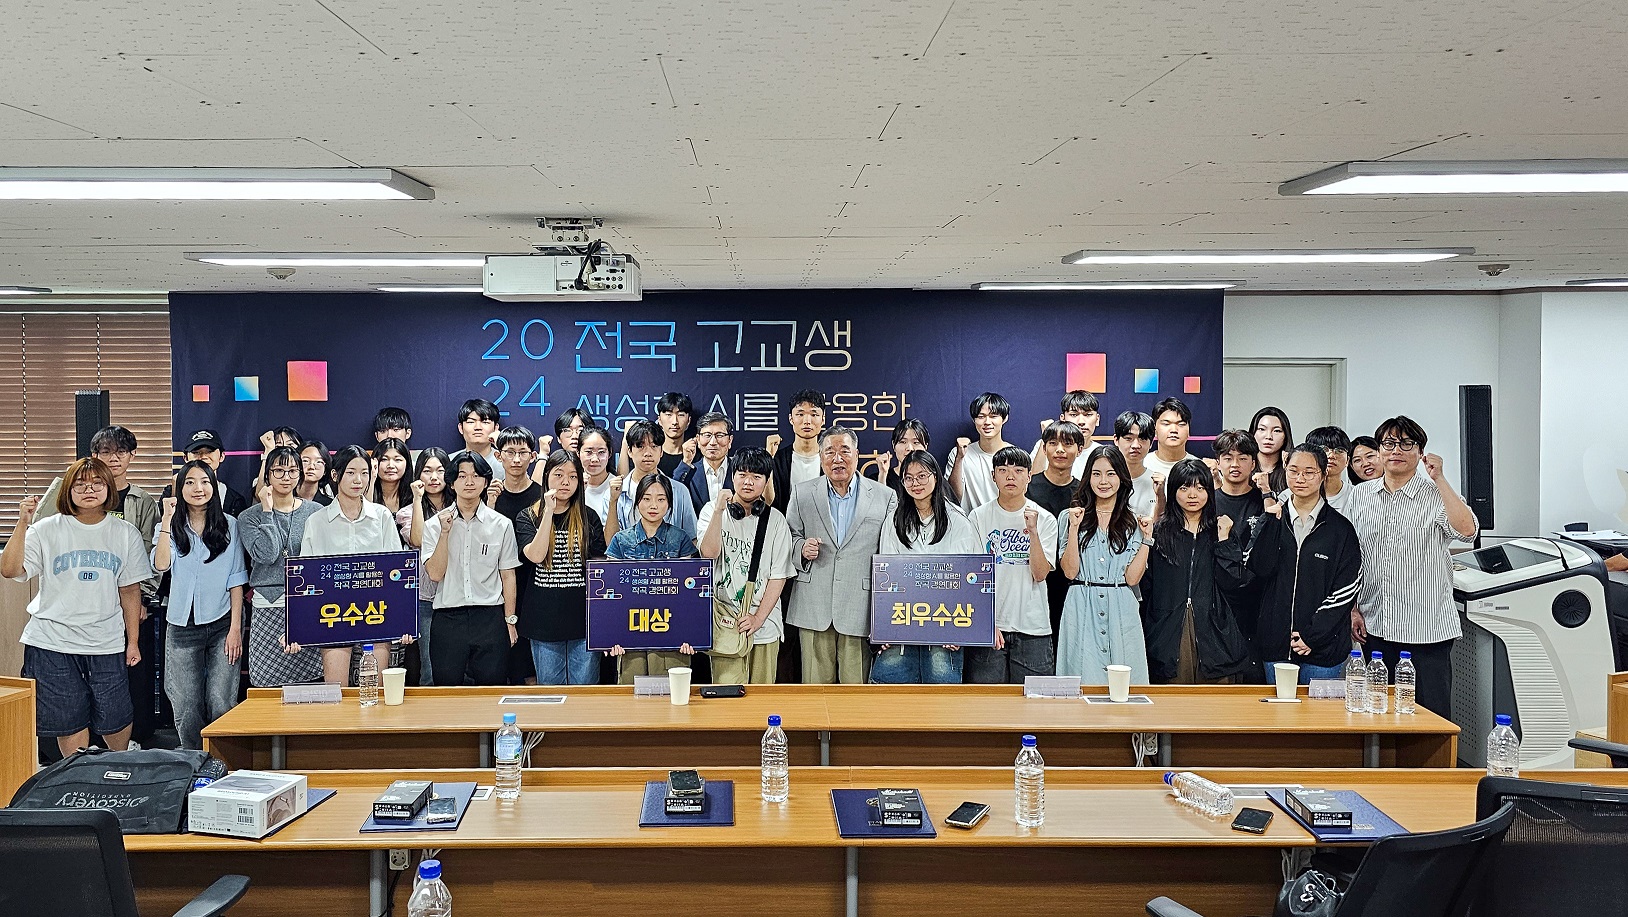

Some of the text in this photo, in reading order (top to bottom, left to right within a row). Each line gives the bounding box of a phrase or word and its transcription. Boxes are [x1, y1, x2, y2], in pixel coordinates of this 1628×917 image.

[481, 318, 853, 373] 20 전국 고교생
[482, 375, 551, 417] 24
[575, 392, 686, 433] 생성
[814, 391, 911, 432] 용한
[1000, 538, 1031, 552] Ocea
[52, 549, 123, 576] COVERNAT
[320, 561, 376, 572] 20 전국 고교생
[82, 572, 93, 580] 08
[320, 572, 332, 580] 24
[619, 567, 672, 577] 20 전국 고교생
[333, 579, 384, 590] 작곡 경연대회
[619, 576, 630, 584] 24
[631, 585, 679, 595] 작곡 경연대회
[320, 600, 388, 628] 우수상
[890, 602, 975, 628] 최우수상
[629, 608, 672, 633] 대상
